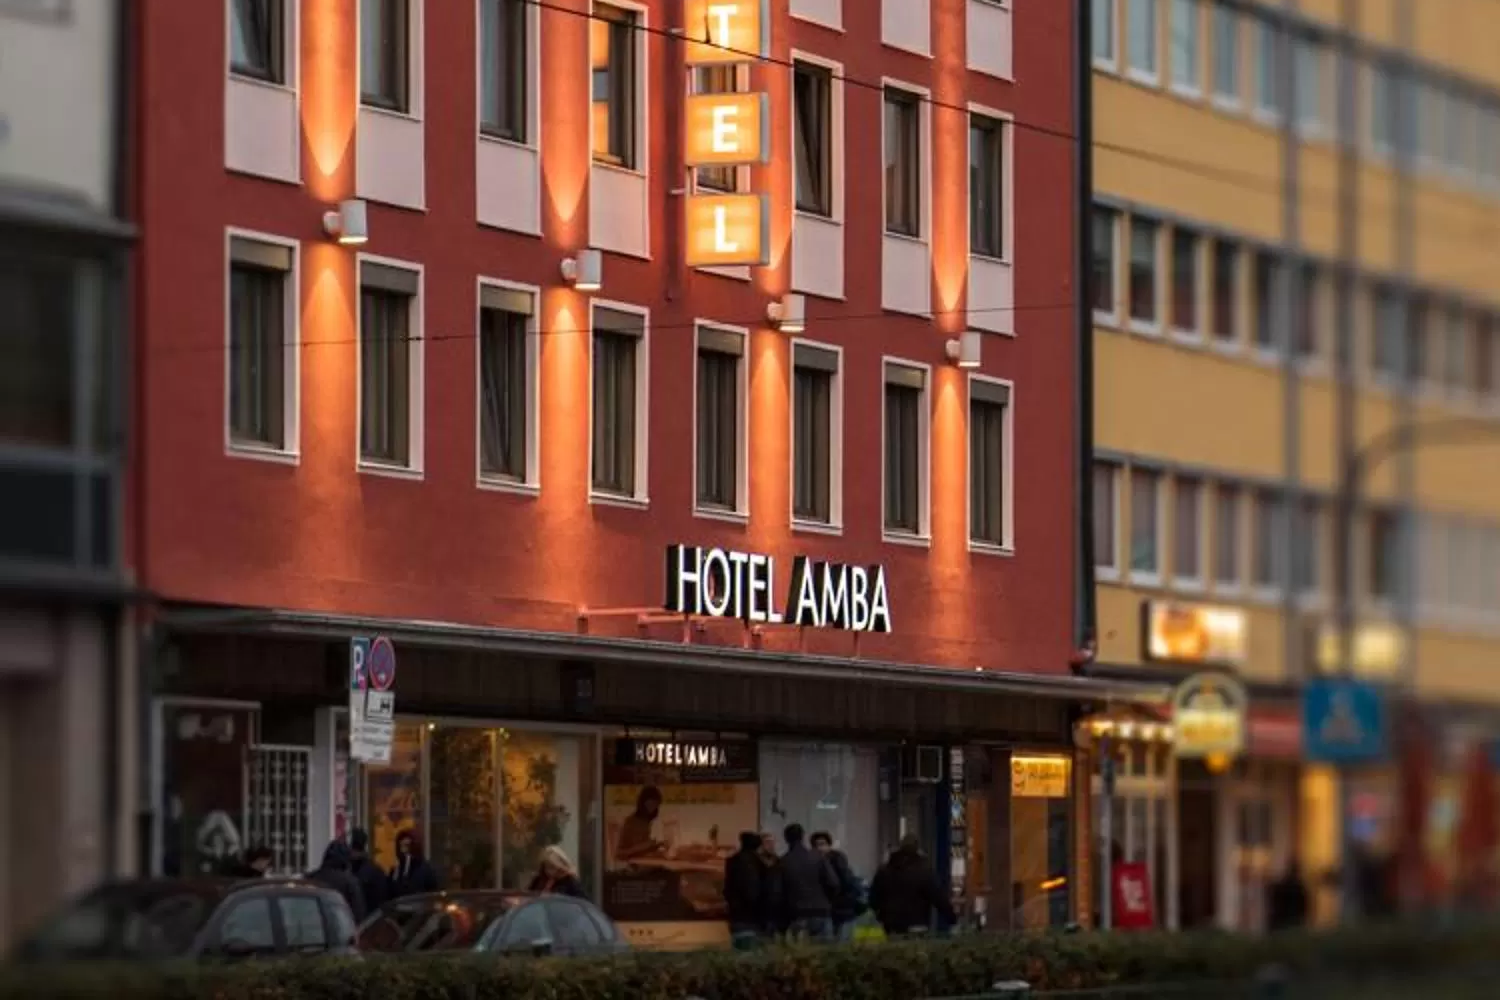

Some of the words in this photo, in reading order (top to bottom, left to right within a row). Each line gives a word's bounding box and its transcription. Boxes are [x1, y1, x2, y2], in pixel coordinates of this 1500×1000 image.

[676, 543, 783, 623] HOTEL
[795, 555, 892, 633] AMBA
[635, 742, 683, 764] HOTEL
[686, 744, 728, 766] AMBA
